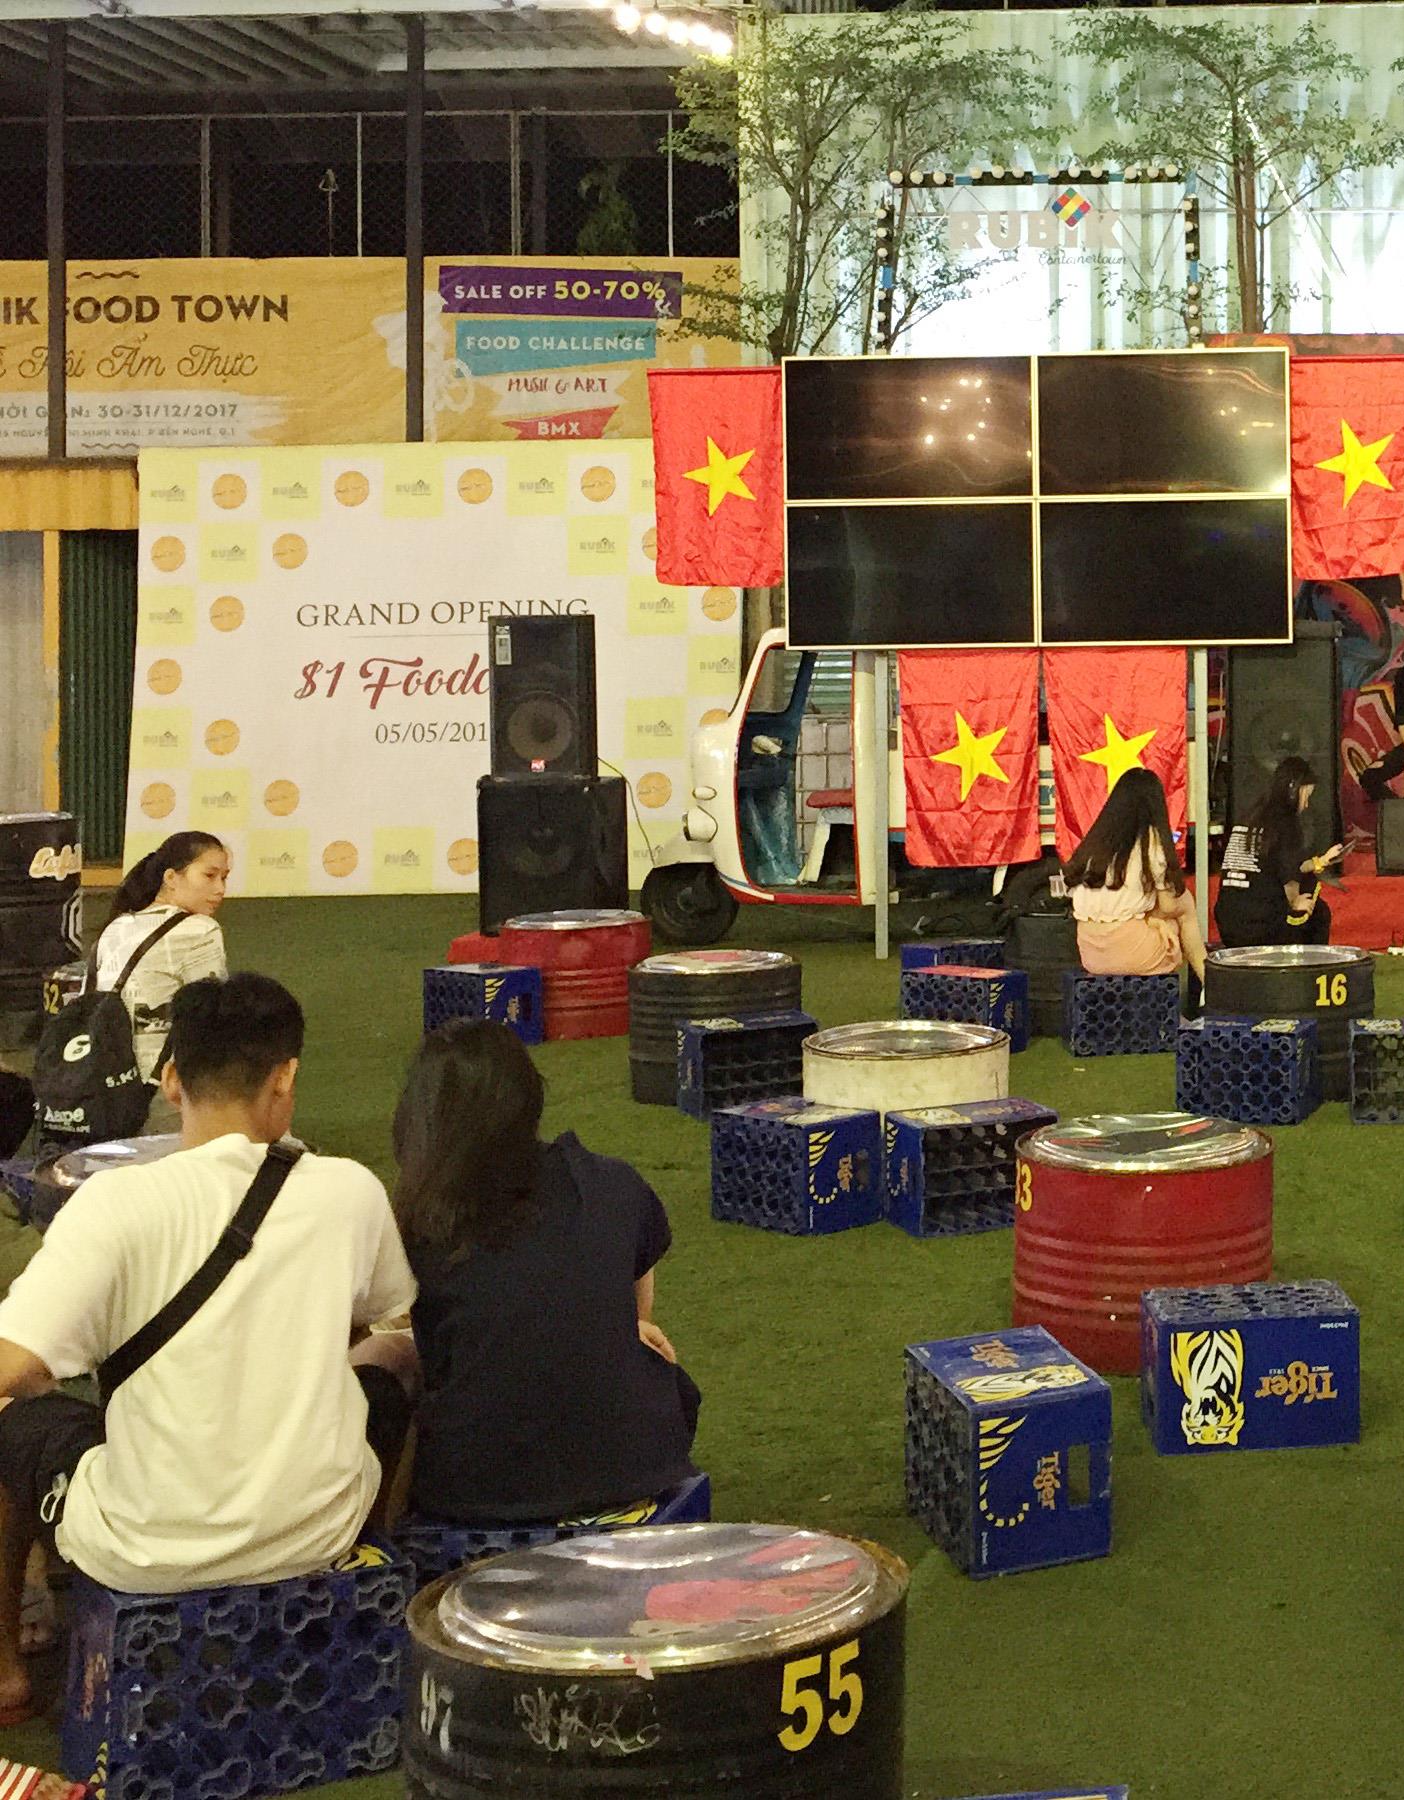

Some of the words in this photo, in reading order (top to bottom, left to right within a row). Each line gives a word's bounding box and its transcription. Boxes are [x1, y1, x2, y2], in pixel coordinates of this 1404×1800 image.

[950, 210, 1122, 250] RUBIK
[454, 285, 502, 299] SALE
[509, 285, 547, 299] OFF
[553, 280, 666, 300] 50-70%
[65, 295, 160, 324] OOD
[171, 294, 289, 323] TOWN
[466, 336, 521, 351] FOOD
[528, 336, 646, 351] CHALLENGE
[177, 344, 258, 384] Thực
[574, 377, 608, 392] ART
[537, 421, 581, 436] BMX
[296, 602, 420, 627] GRAND
[431, 599, 588, 624] OPENING
[294, 660, 346, 700] $1
[359, 653, 490, 710] Foodc
[375, 722, 488, 744] 05/05/201
[1316, 973, 1347, 1006] 16
[1254, 1361, 1338, 1406] Tiger
[1033, 1451, 1060, 1510] Tiger
[777, 1639, 863, 1751] 55
